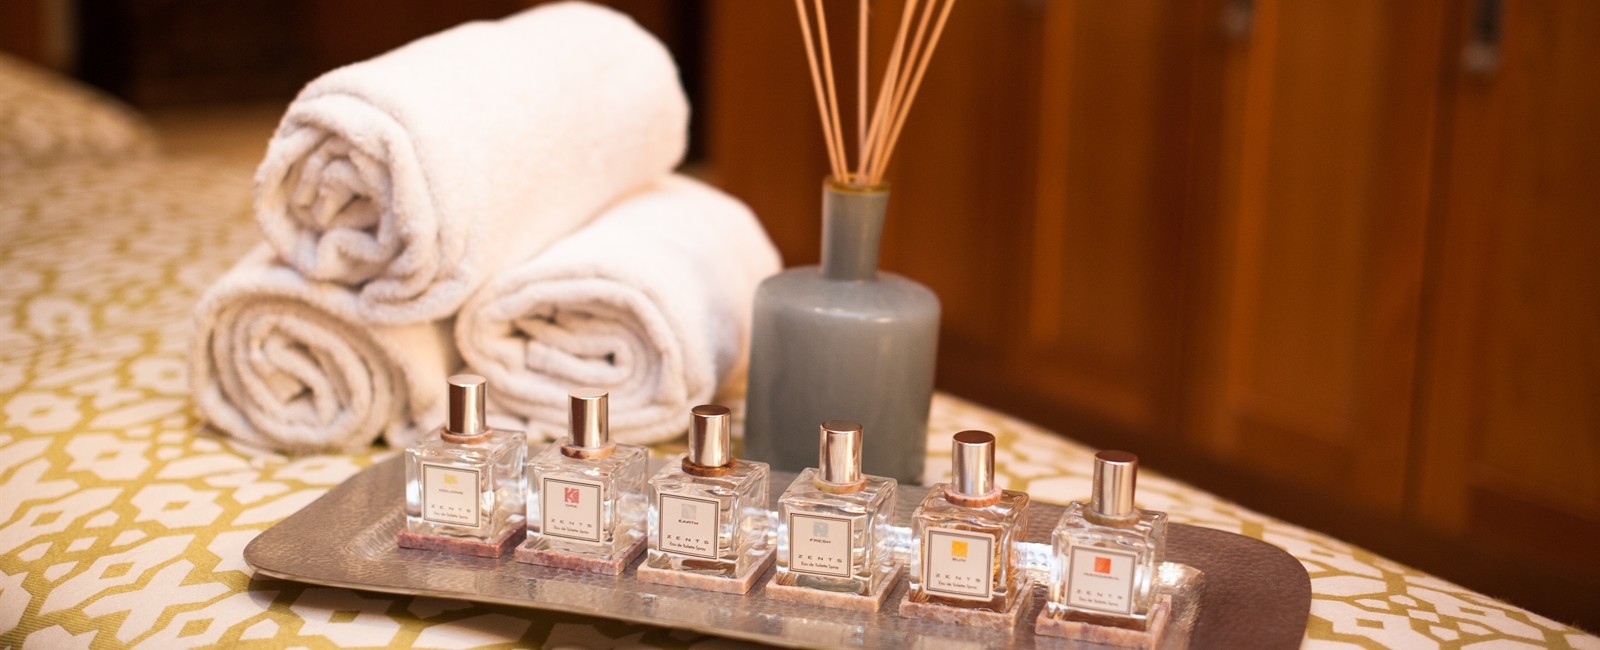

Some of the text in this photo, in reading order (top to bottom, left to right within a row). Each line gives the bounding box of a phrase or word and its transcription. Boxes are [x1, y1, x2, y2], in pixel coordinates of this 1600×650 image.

[432, 504, 471, 513] ZENTS
[552, 518, 592, 528] ZENTS
[667, 534, 710, 545] ZENTS
[798, 554, 842, 563] ZENTS
[936, 573, 981, 583] ZENTS
[1076, 589, 1122, 600] ZENTS
